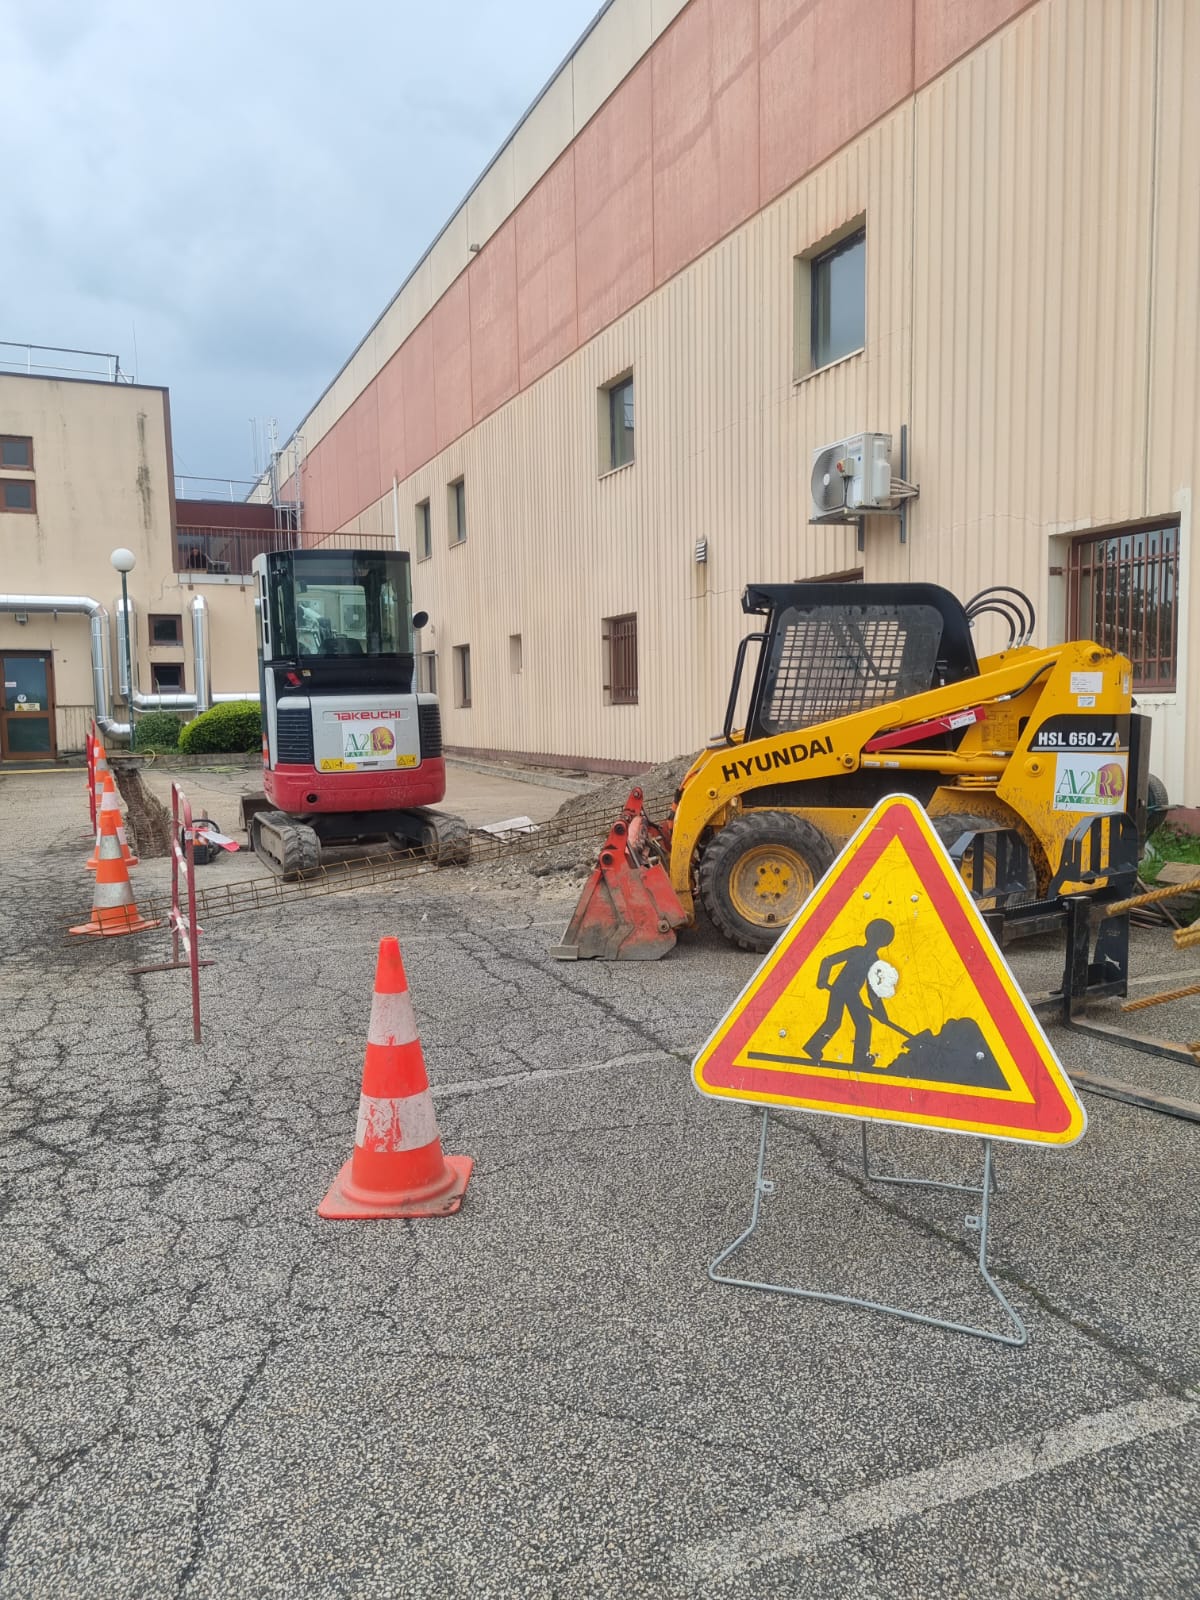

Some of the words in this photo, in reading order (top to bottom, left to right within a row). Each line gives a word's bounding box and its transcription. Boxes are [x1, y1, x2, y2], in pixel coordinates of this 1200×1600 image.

[1038, 732, 1066, 745] HSL
[1069, 732, 1120, 746] 650-7A
[721, 736, 834, 782] HYUNDAI
